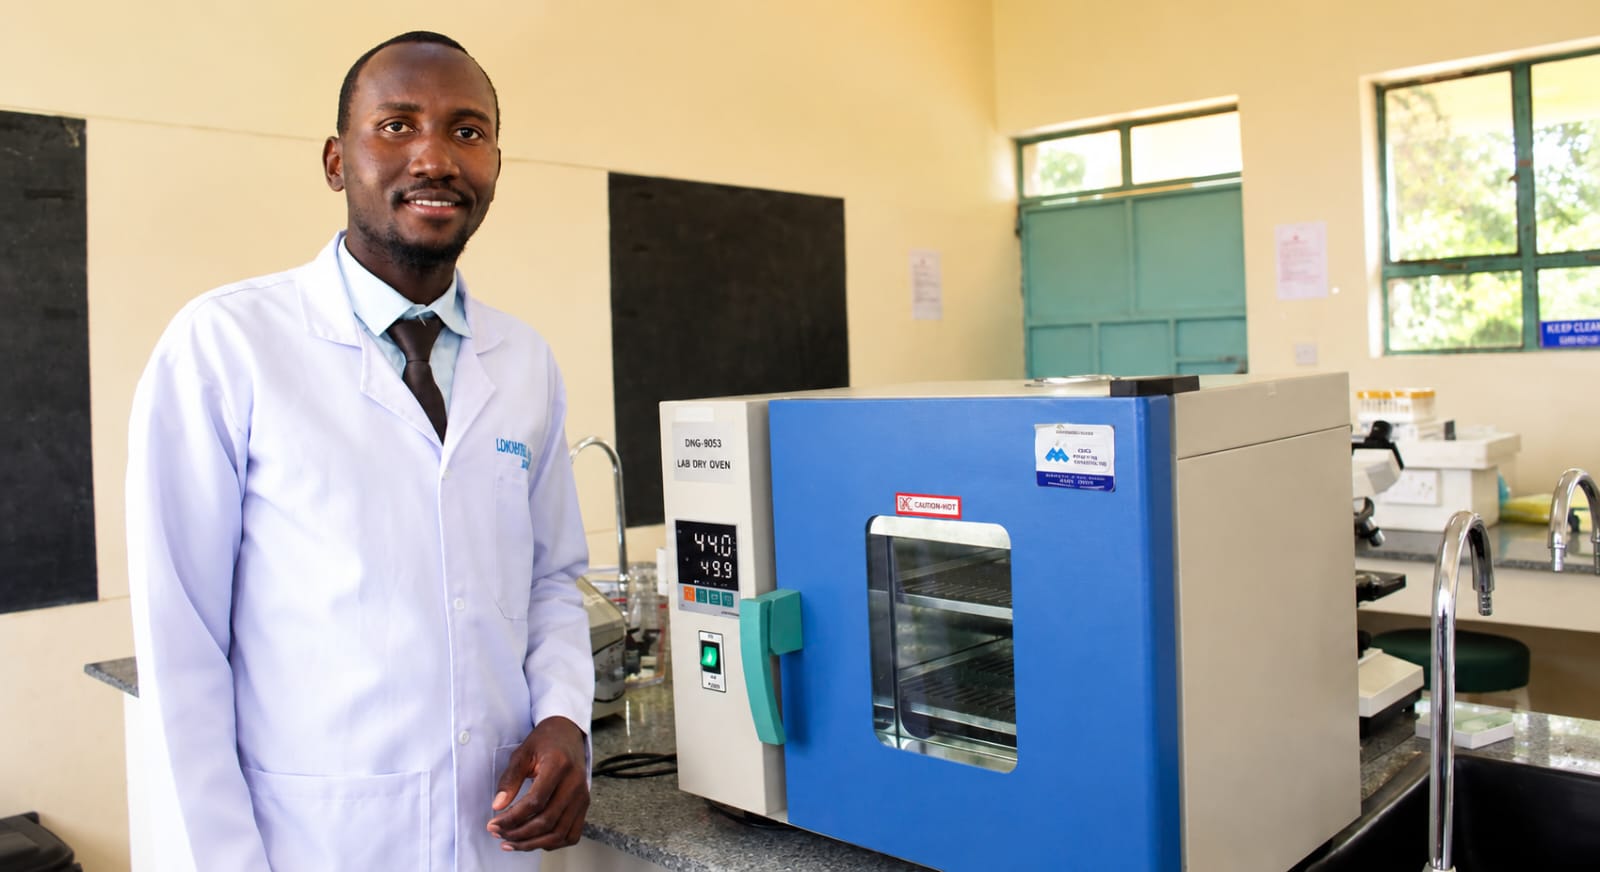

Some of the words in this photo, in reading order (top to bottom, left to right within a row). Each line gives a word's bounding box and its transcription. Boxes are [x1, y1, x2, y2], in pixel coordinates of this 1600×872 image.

[685, 438, 721, 448] DNG-9053
[677, 459, 690, 468] LAB
[692, 459, 706, 469] DRY
[709, 460, 731, 470] OVEN
[694, 532, 731, 557] 44.0
[700, 560, 732, 579] 49.9
